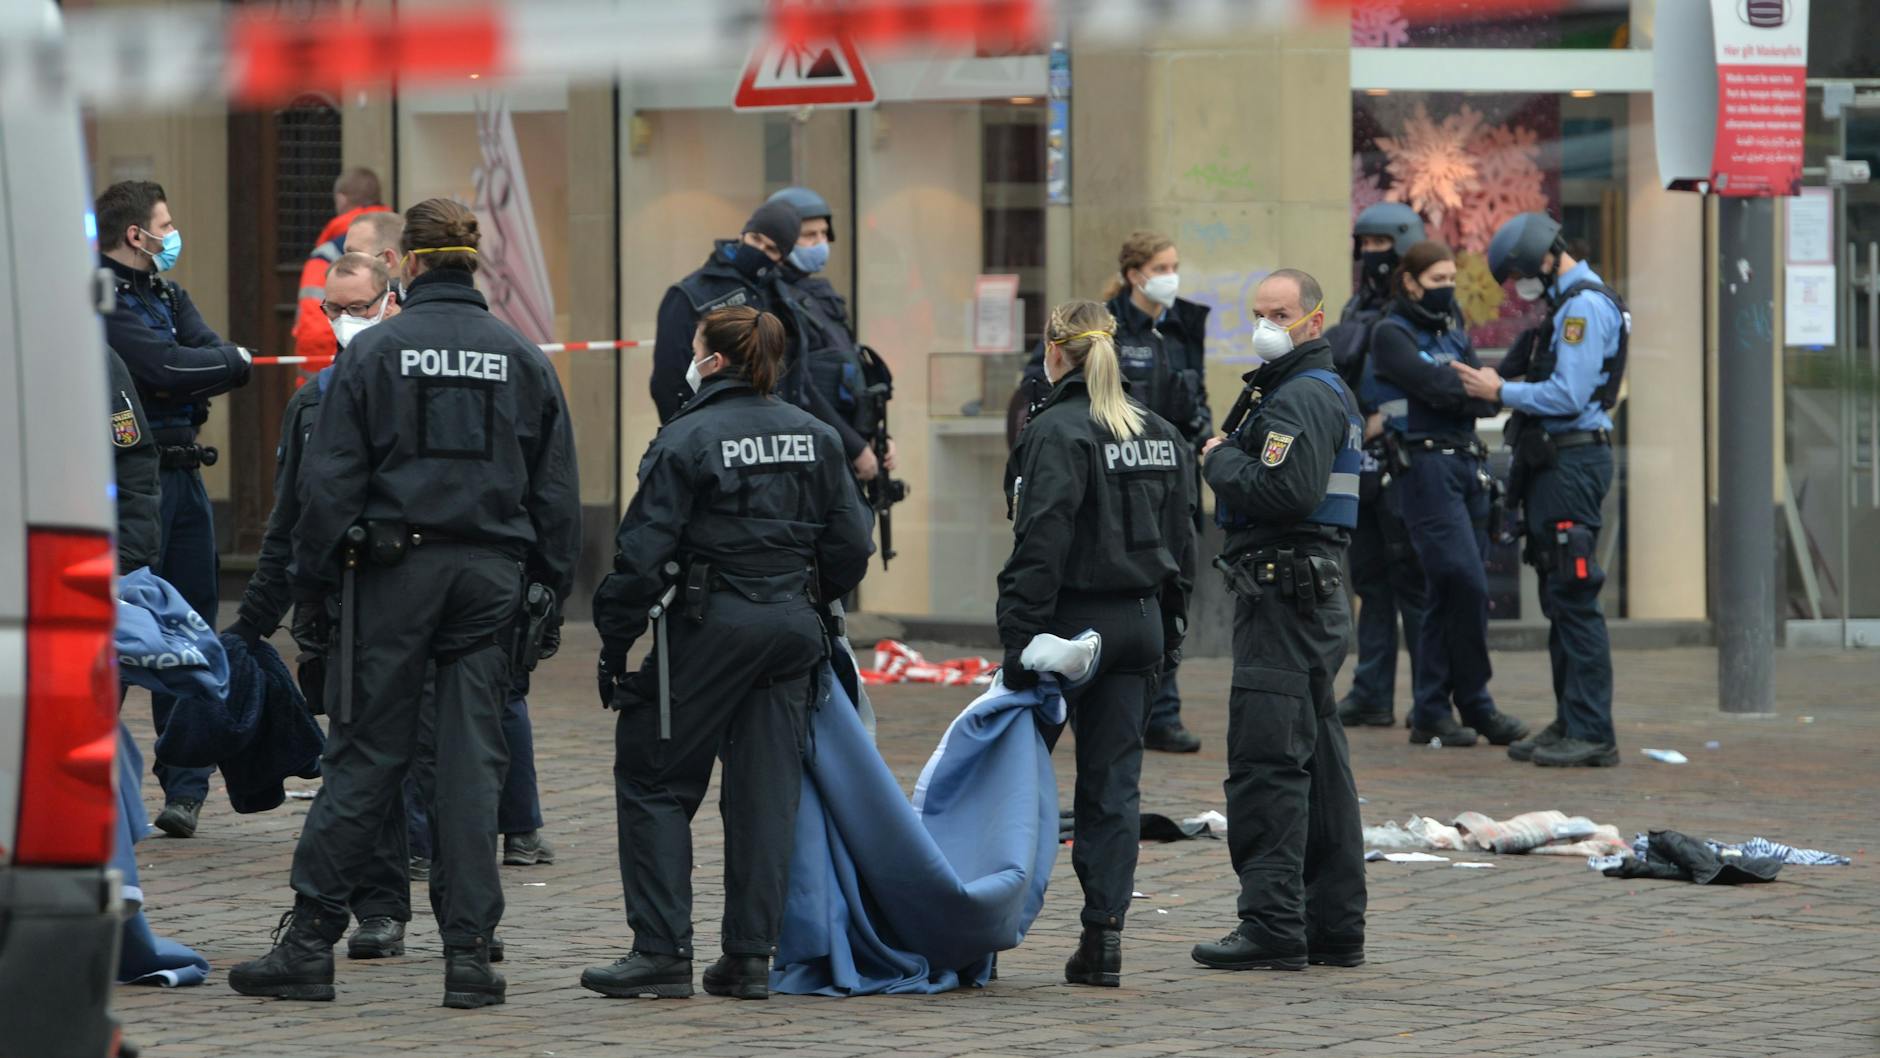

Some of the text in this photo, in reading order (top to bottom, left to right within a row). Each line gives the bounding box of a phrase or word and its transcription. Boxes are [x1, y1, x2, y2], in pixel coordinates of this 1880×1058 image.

[400, 348, 508, 382] POLIZEI
[721, 434, 816, 468] POLIZEI
[1104, 440, 1177, 470] POLIZEI
